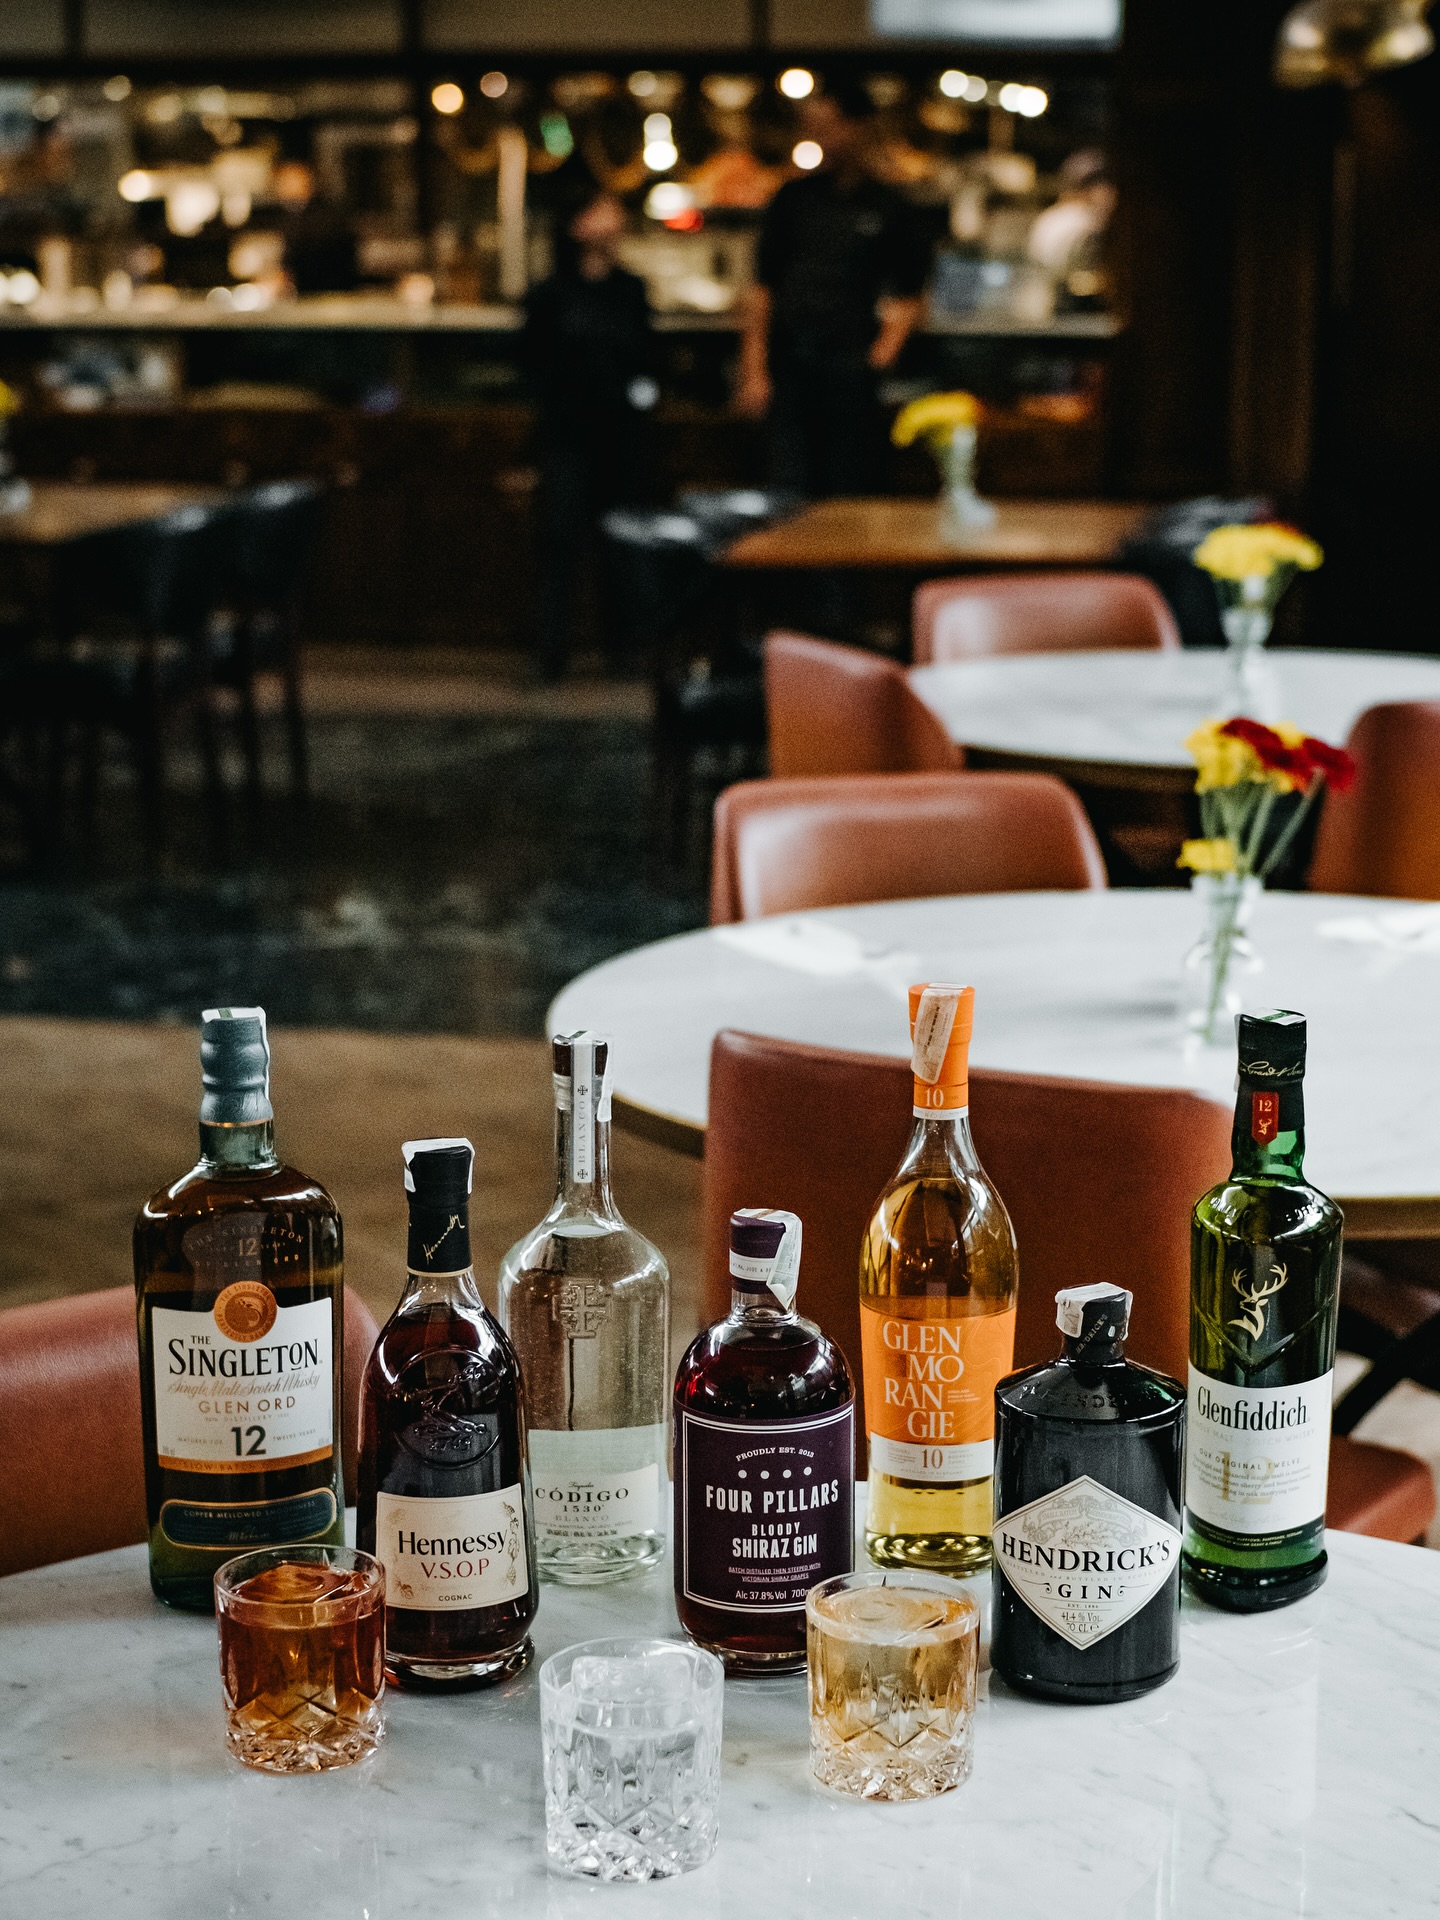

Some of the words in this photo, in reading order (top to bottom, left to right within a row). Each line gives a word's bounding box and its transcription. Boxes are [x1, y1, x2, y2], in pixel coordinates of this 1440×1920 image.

[924, 1088, 944, 1107] 10
[1259, 1100, 1272, 1112] 12
[239, 1238, 258, 1257] 12
[191, 1335, 211, 1345] THE
[882, 1320, 962, 1354] GLEN
[168, 1338, 319, 1378] SINGLETON
[908, 1354, 965, 1383] MO
[168, 1377, 208, 1398] Single
[207, 1379, 241, 1396] Malt
[241, 1377, 282, 1396] Scotch
[282, 1371, 321, 1393] Whisky
[885, 1377, 943, 1410] RAN
[198, 1400, 249, 1414] GLEN
[257, 1395, 296, 1412] ORD
[1197, 1385, 1307, 1431] Glenfiddich
[907, 1410, 955, 1439] GIE
[230, 1425, 267, 1456] 12
[735, 1447, 775, 1462] PROUDLY
[778, 1446, 796, 1454] EST.
[798, 1448, 815, 1458] 2013
[921, 1448, 943, 1469] 10
[1267, 1457, 1301, 1470] TWELVE
[535, 1487, 629, 1502] CÓDIGO
[706, 1484, 752, 1513] FOUR
[763, 1479, 839, 1514] PILLARS
[184, 1510, 213, 1518] COPPER
[216, 1510, 262, 1519] MELLOWED
[555, 1514, 609, 1522] BLANCO
[562, 1504, 602, 1513] 1530
[751, 1522, 801, 1536] BLOODY
[398, 1529, 508, 1556] Hennessy
[732, 1537, 790, 1558] SHIRAZ
[793, 1534, 818, 1555] GIN
[1001, 1531, 1171, 1572] HENDRICK'S
[421, 1558, 490, 1579] V.S.O.P
[728, 1566, 746, 1574] BATCH
[787, 1565, 808, 1573] STEEPED
[809, 1562, 821, 1570] WITH
[438, 1593, 473, 1602] COGNAC
[735, 1590, 748, 1599] Alc
[749, 1591, 775, 1600] 37.8%
[774, 1590, 787, 1599] Vol
[791, 1588, 811, 1598] 700m
[1057, 1583, 1113, 1600] GIN
[1066, 1622, 1076, 1632] 70
